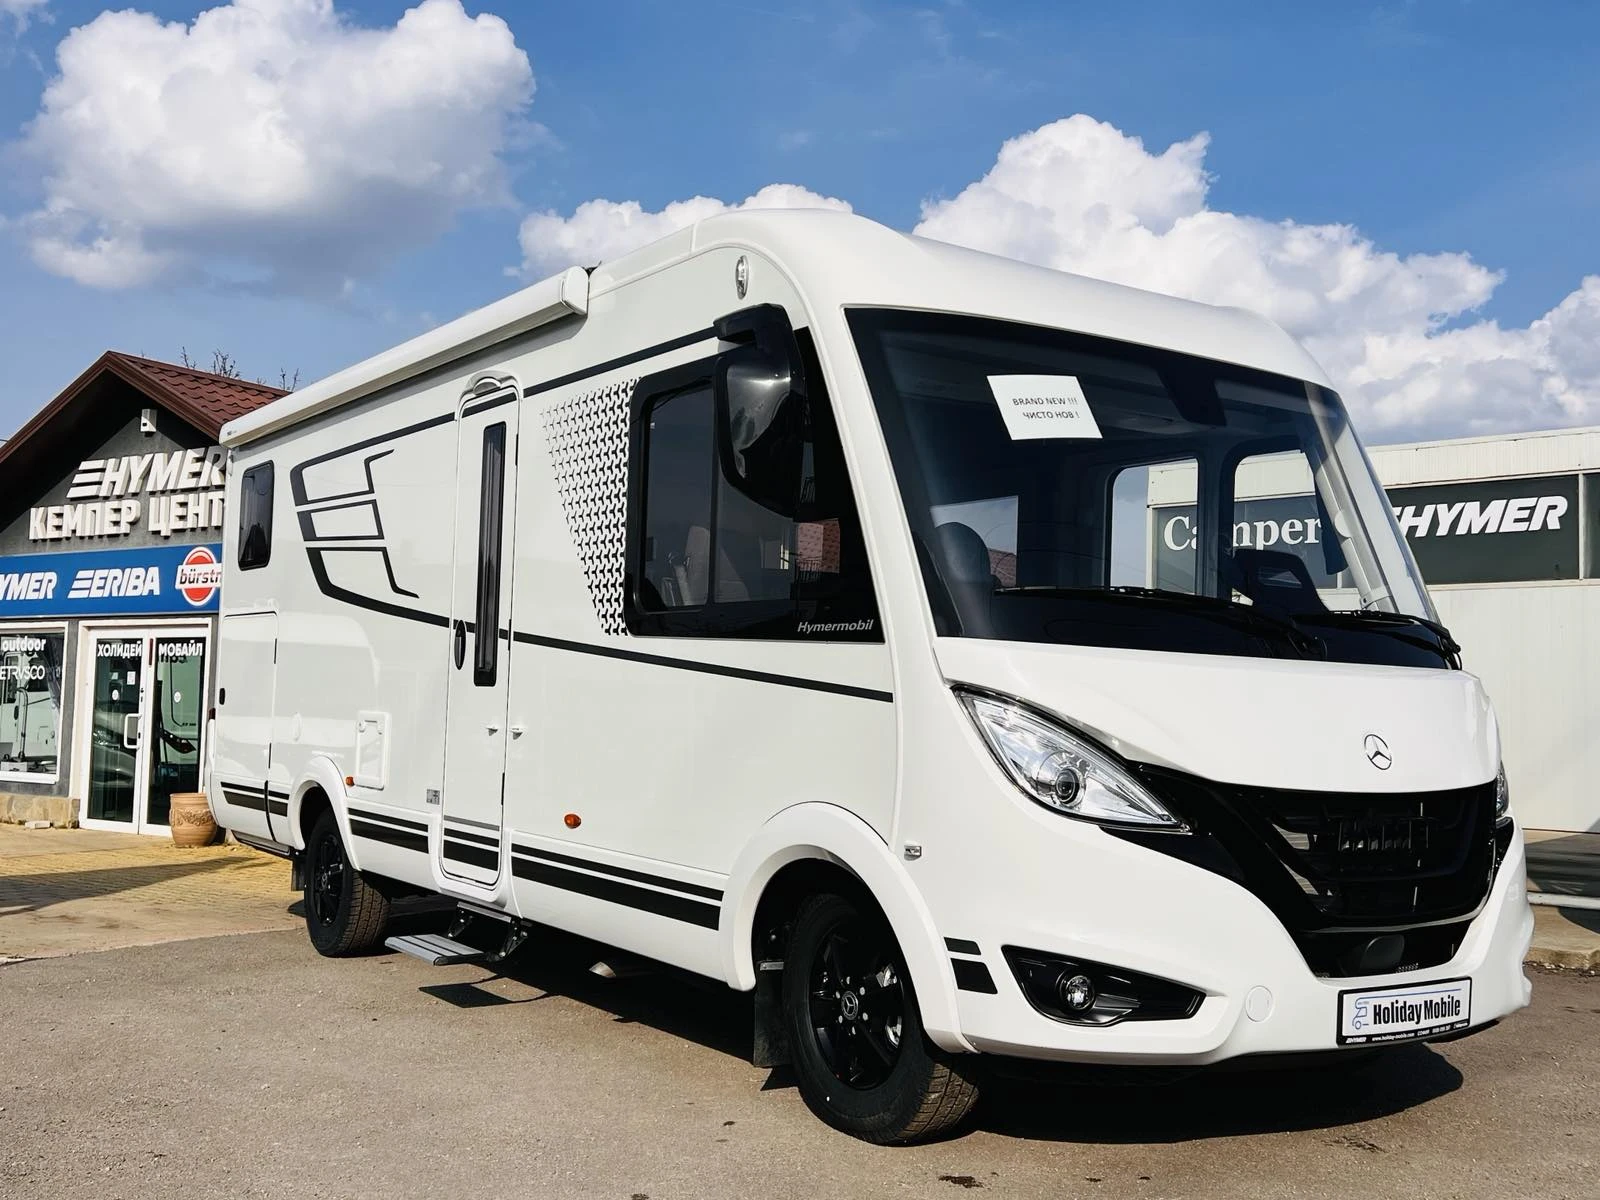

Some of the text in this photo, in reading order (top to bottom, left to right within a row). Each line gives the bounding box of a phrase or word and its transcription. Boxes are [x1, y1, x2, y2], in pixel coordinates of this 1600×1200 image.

[1012, 397, 1044, 406] BRAND
[1046, 397, 1066, 405] NEW
[1022, 411, 1054, 419] ЧИСТО
[1055, 411, 1075, 419] НОВ
[99, 445, 227, 497] HYMER
[29, 500, 140, 540] КЕМПЕР
[1400, 495, 1568, 538] HYMER
[87, 566, 160, 598] ERIBA
[797, 619, 874, 634] Hymermobil
[2, 635, 47, 651] outdoor
[97, 640, 204, 659] ХОЛИДЕЙ МОБАЙЛ
[1373, 994, 1461, 1025] Holiday Mobile
